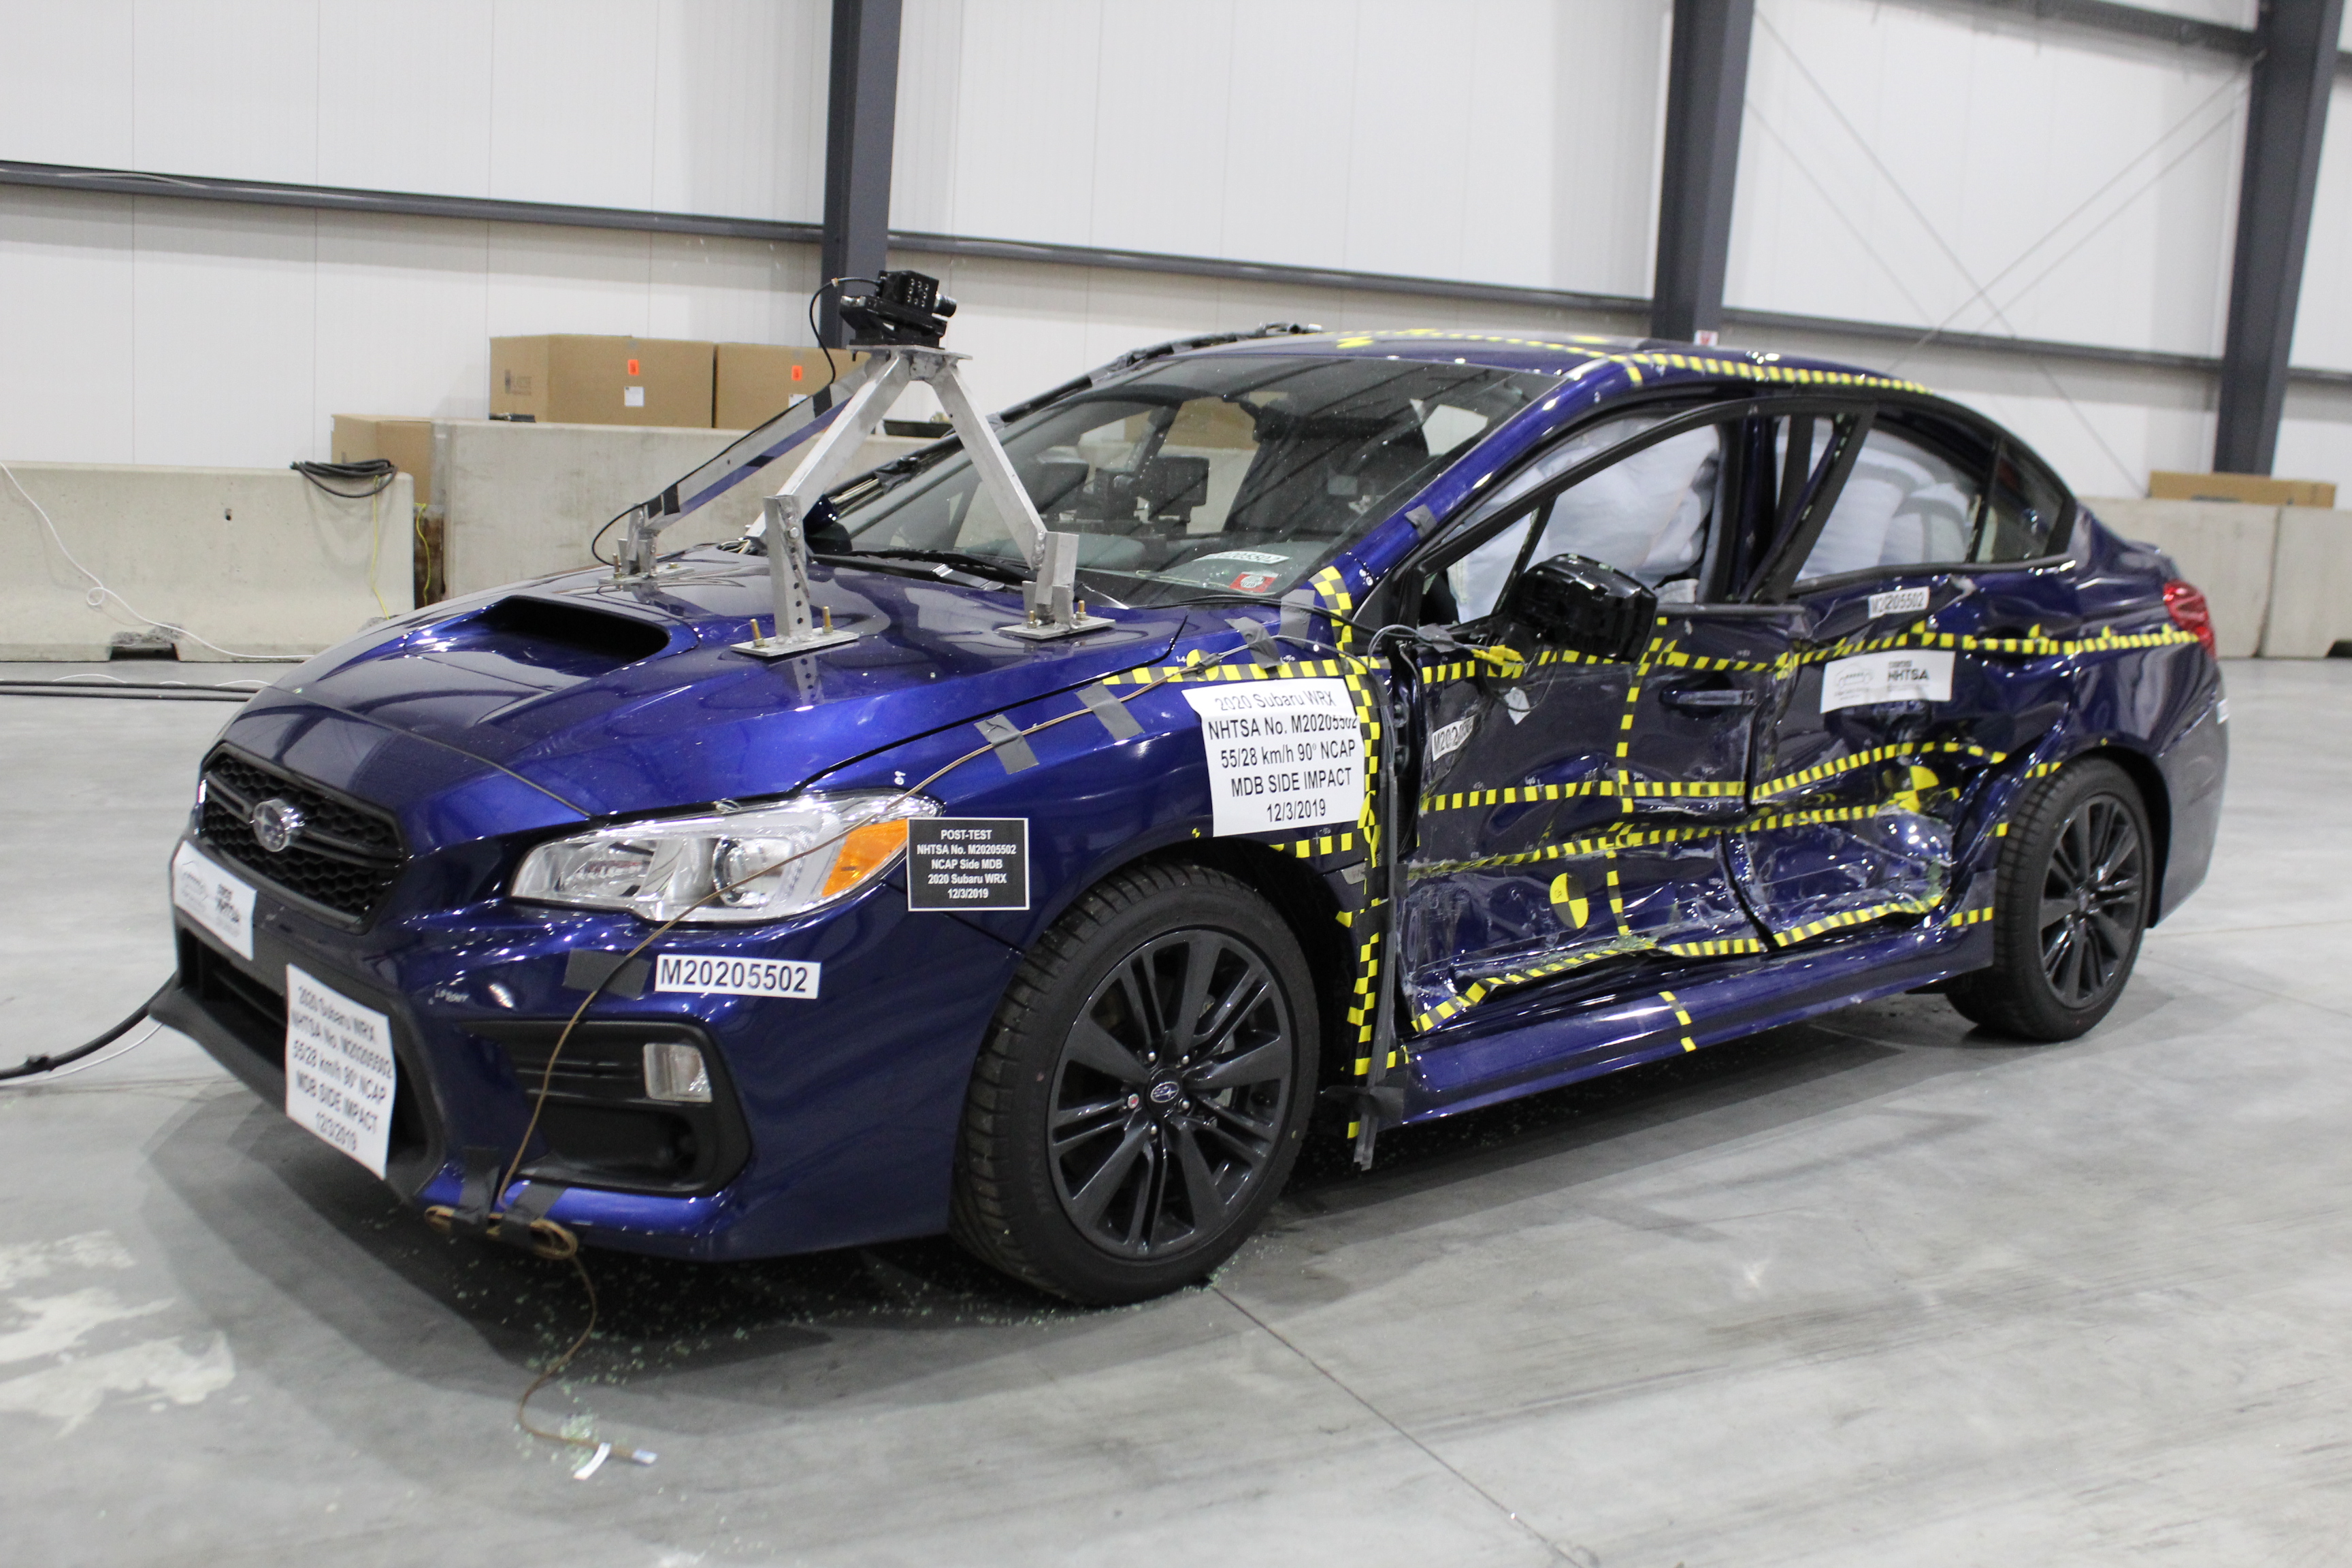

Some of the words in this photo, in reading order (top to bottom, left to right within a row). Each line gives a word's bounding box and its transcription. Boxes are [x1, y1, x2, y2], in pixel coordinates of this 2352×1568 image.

[1888, 670, 1929, 681] NHTSA
[1214, 694, 1253, 711] 2020
[1256, 691, 1305, 708] Subaru
[1303, 690, 1337, 706] WRX
[1207, 718, 1261, 740] NHTSA
[1264, 717, 1288, 736] No.
[1291, 714, 1358, 734] M20205502
[1220, 747, 1258, 768] 55/28
[1261, 744, 1294, 765] km/h
[1320, 739, 1356, 760] NCAP
[1230, 777, 1264, 797] MDB
[1269, 772, 1301, 794] SIDE
[1303, 767, 1352, 789] IMPACT
[1266, 798, 1326, 822] 12/3/2019
[940, 829, 992, 840] POST-TEST
[916, 845, 949, 855] NHTSA
[951, 845, 966, 855] No.
[968, 845, 1017, 855] M20205502
[931, 859, 958, 870] NCAP
[960, 859, 980, 870] Side
[981, 859, 1003, 870] MDB
[927, 874, 949, 885] 2020
[951, 874, 983, 885] Subaru
[984, 873, 1007, 884] WRX
[947, 888, 989, 899] 12/3/2019
[660, 958, 808, 993] M20205502
